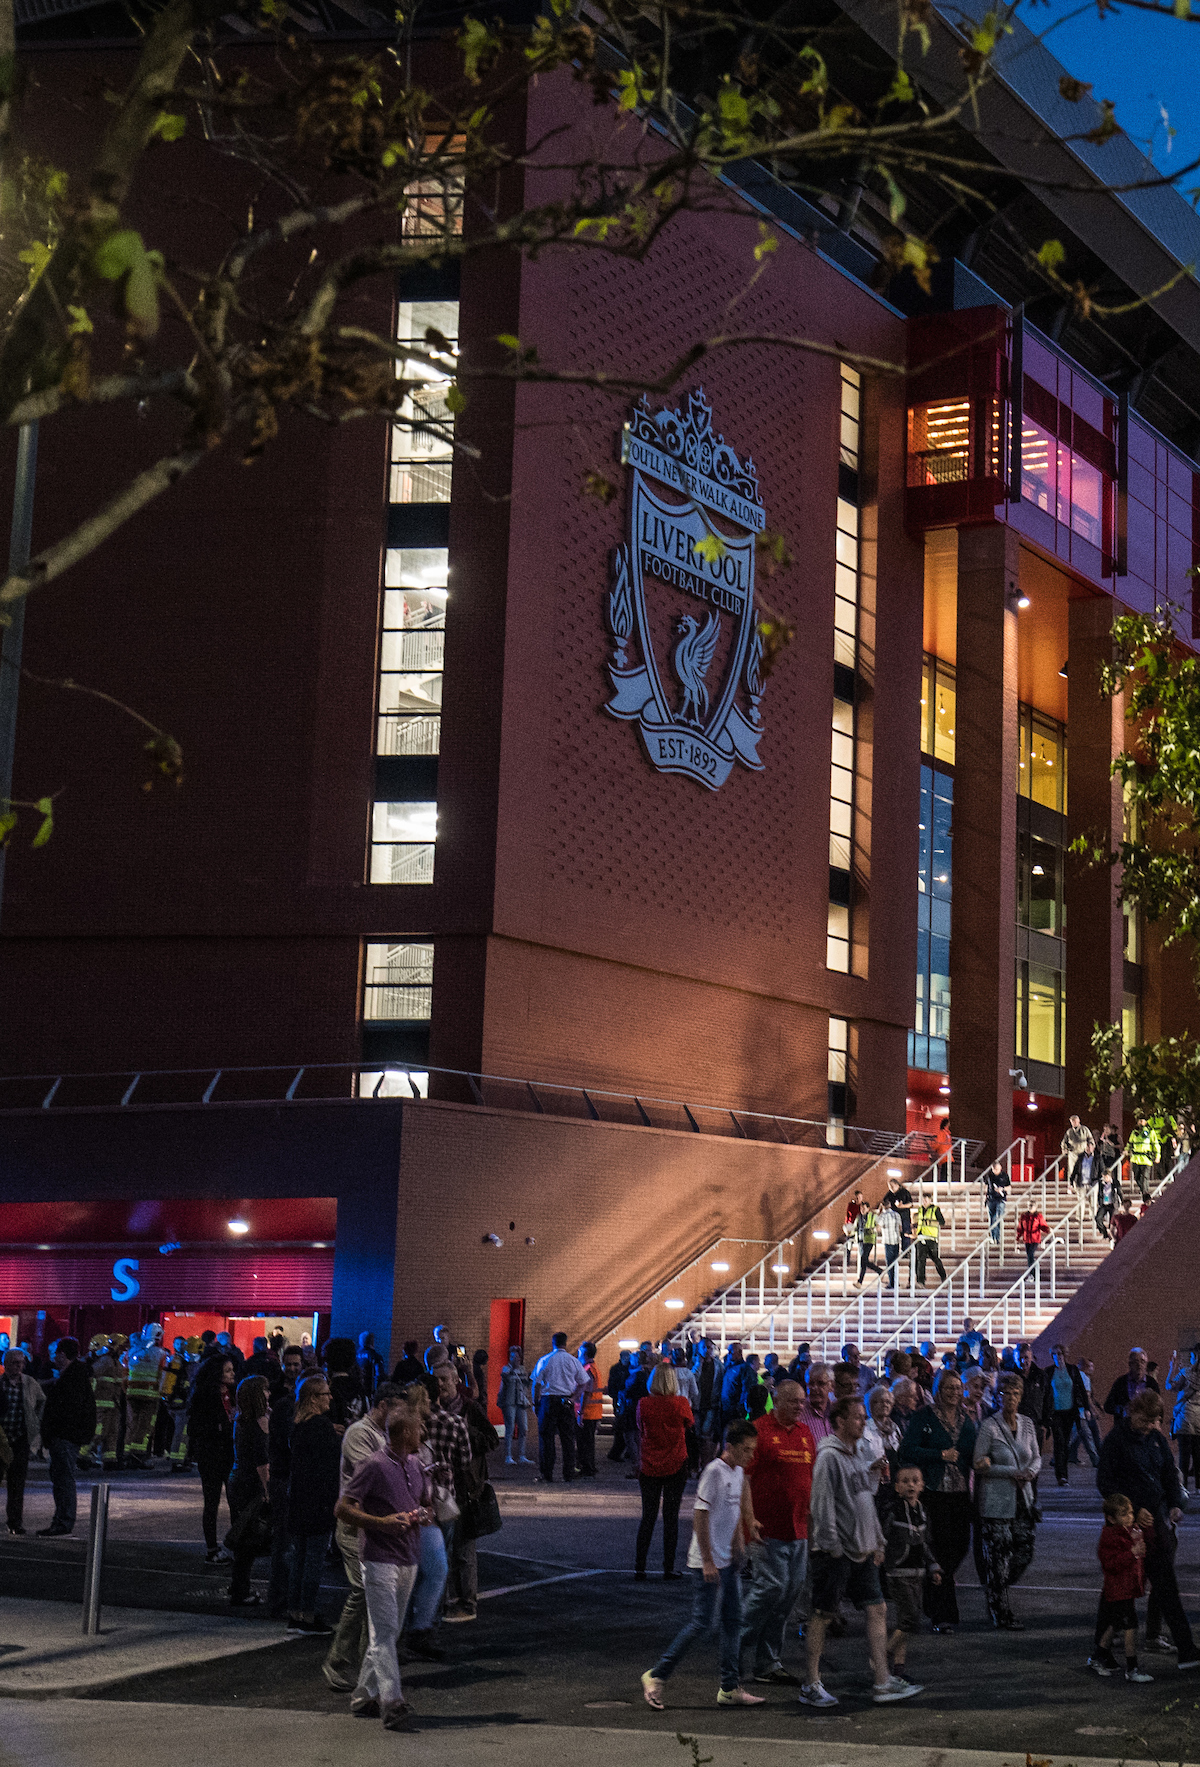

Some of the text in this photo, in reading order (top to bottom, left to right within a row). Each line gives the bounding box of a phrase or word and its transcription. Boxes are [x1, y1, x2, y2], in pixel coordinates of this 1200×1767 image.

[629, 440, 763, 529] OU'LL NEVER WALK ALONE
[644, 552, 742, 616] FOOTBALL CLUB
[110, 1257, 141, 1302] S
